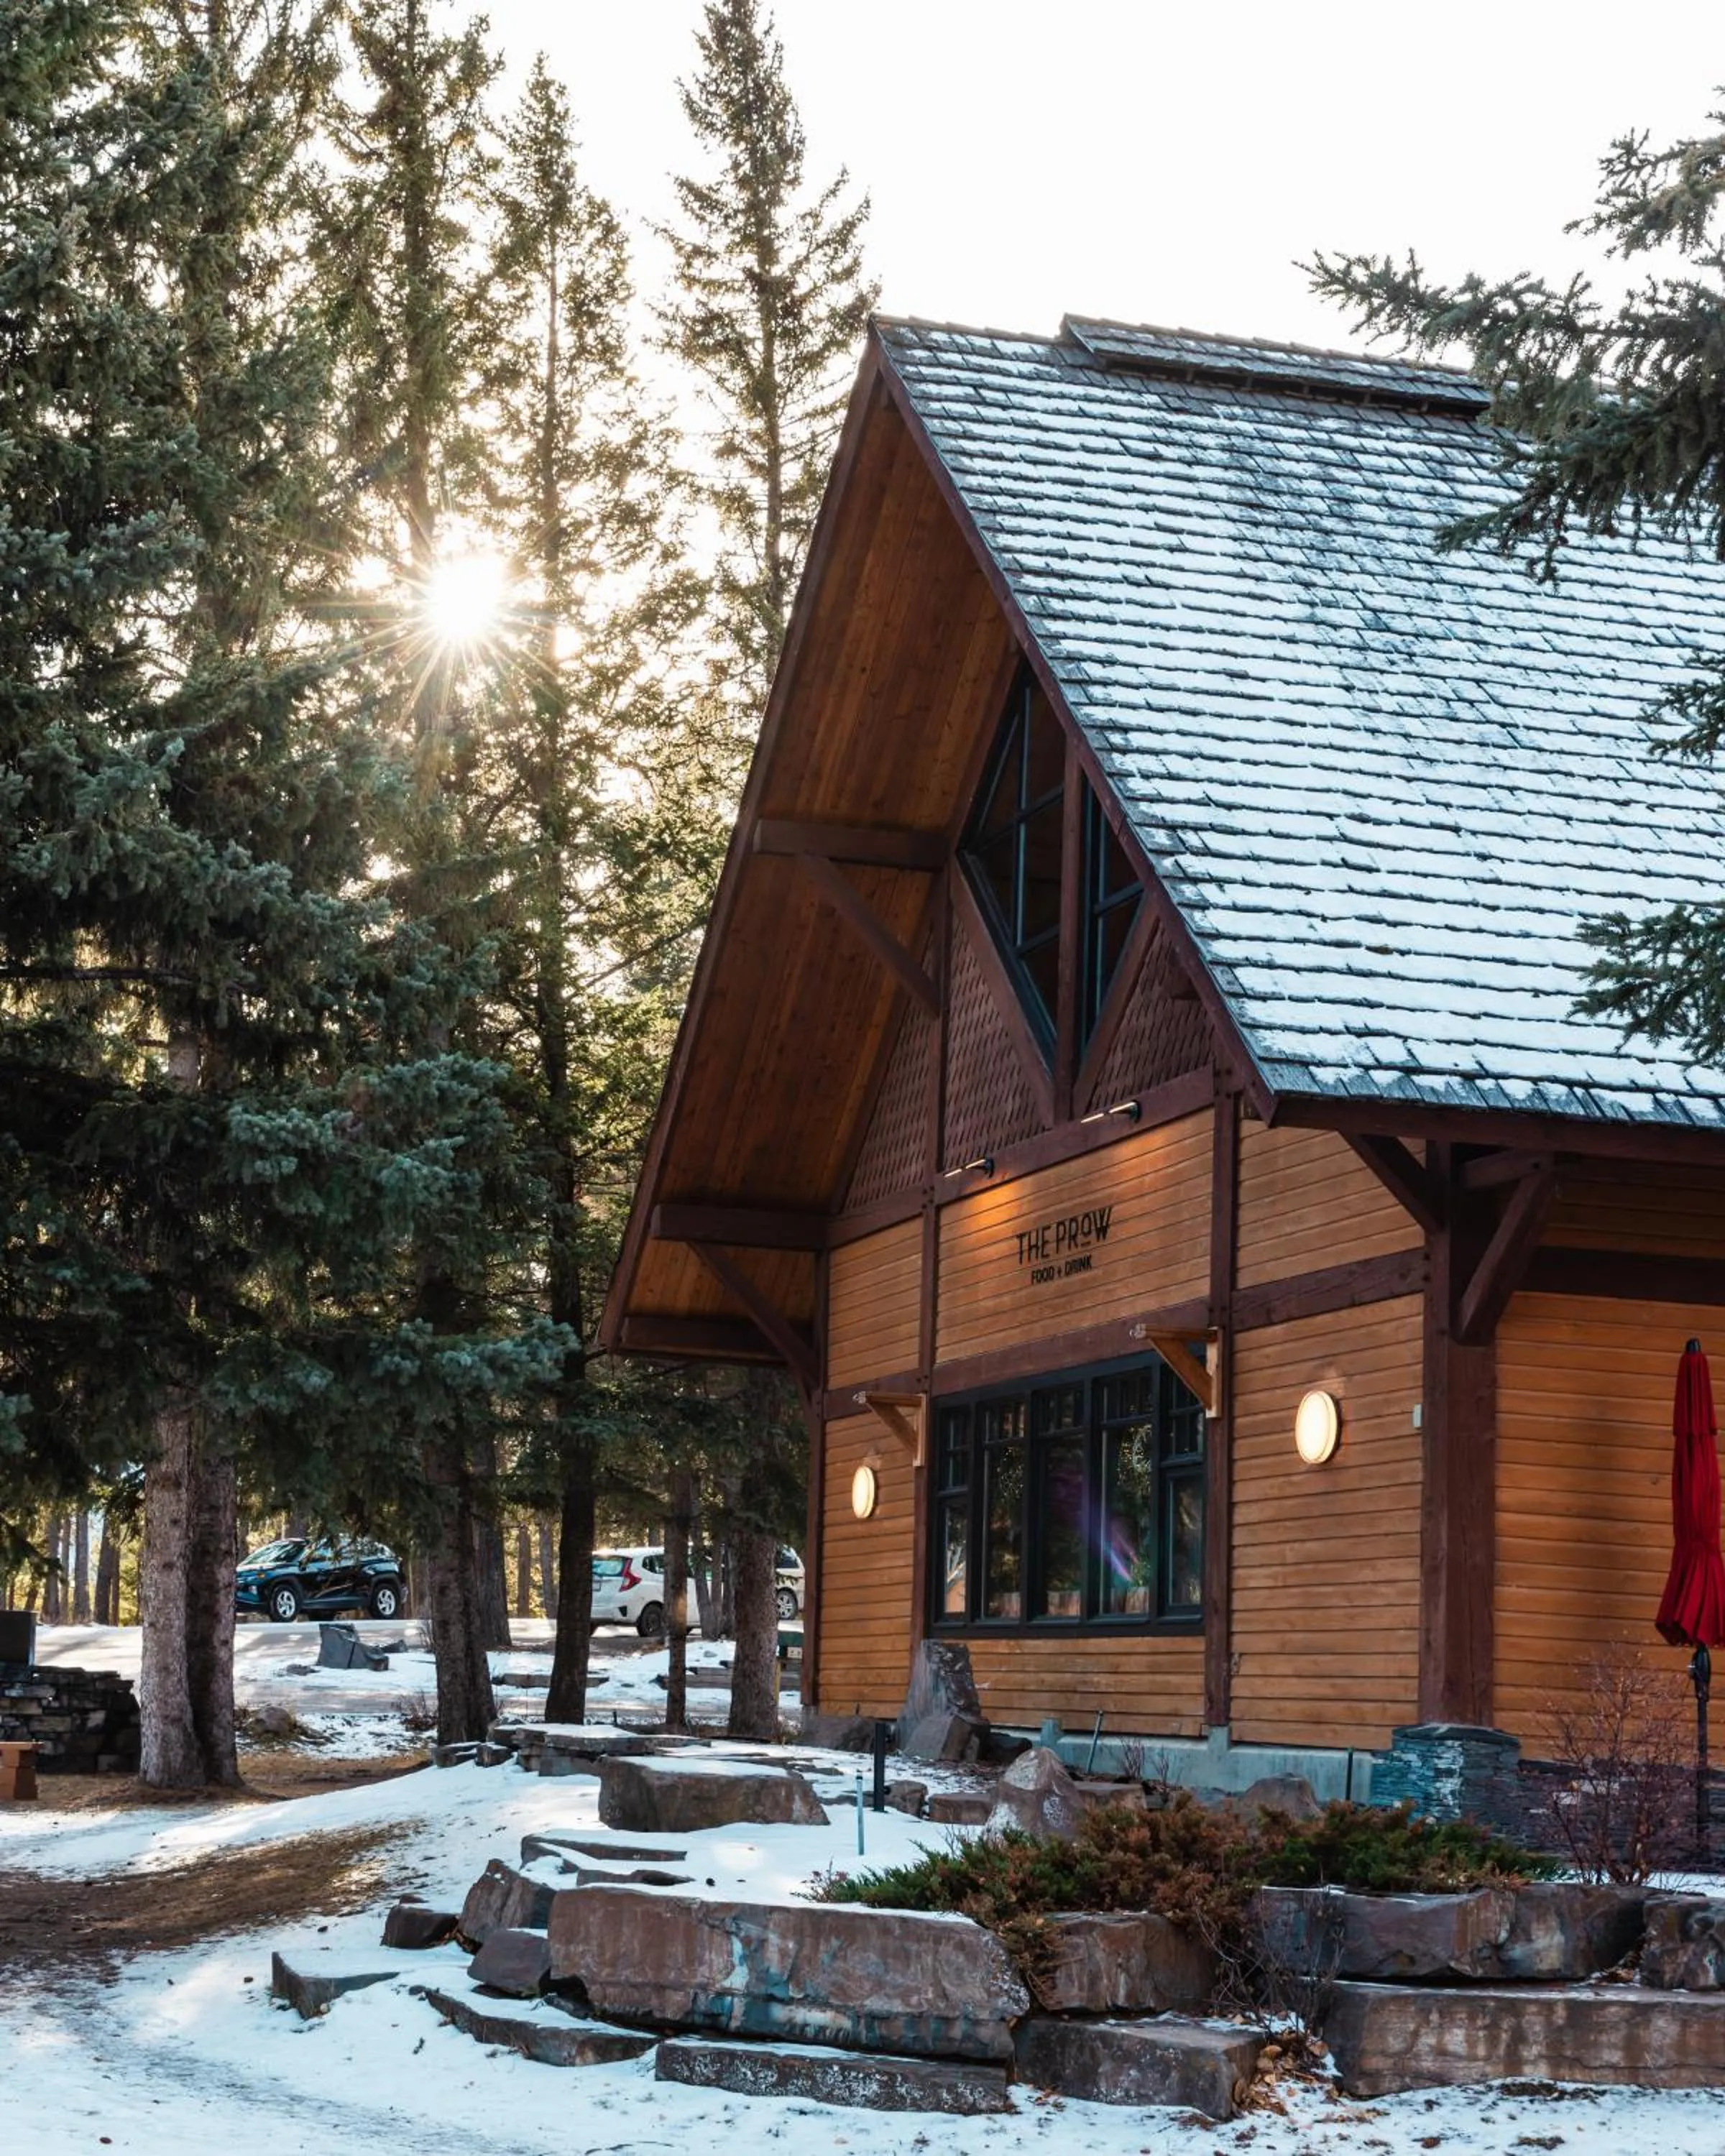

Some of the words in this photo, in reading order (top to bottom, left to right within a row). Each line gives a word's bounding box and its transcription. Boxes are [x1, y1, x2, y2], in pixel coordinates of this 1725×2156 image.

[1016, 1225, 1051, 1265] THE
[1055, 1207, 1113, 1253] PROW
[1031, 1266, 1054, 1285] FOOD
[1064, 1254, 1092, 1277] DRINK
